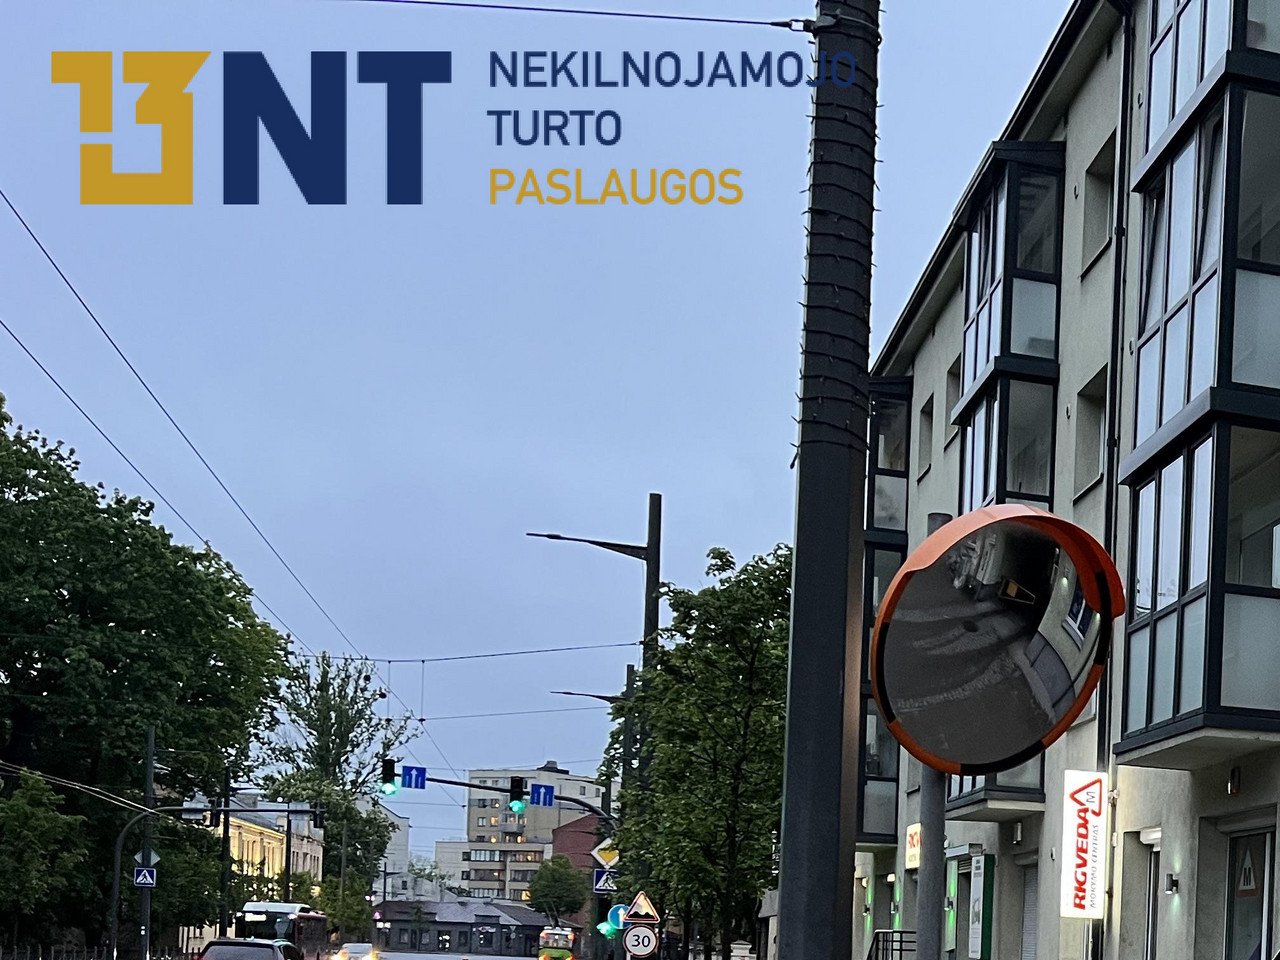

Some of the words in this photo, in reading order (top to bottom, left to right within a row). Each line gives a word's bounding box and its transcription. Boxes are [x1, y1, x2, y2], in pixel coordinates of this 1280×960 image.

[1085, 791, 1097, 803] M
[1072, 806, 1090, 911] RIGVEDA
[1091, 824, 1099, 864] CENTRAS
[1089, 867, 1098, 909] MOKYMO
[1242, 866, 1252, 887] M
[631, 934, 651, 948] 30
